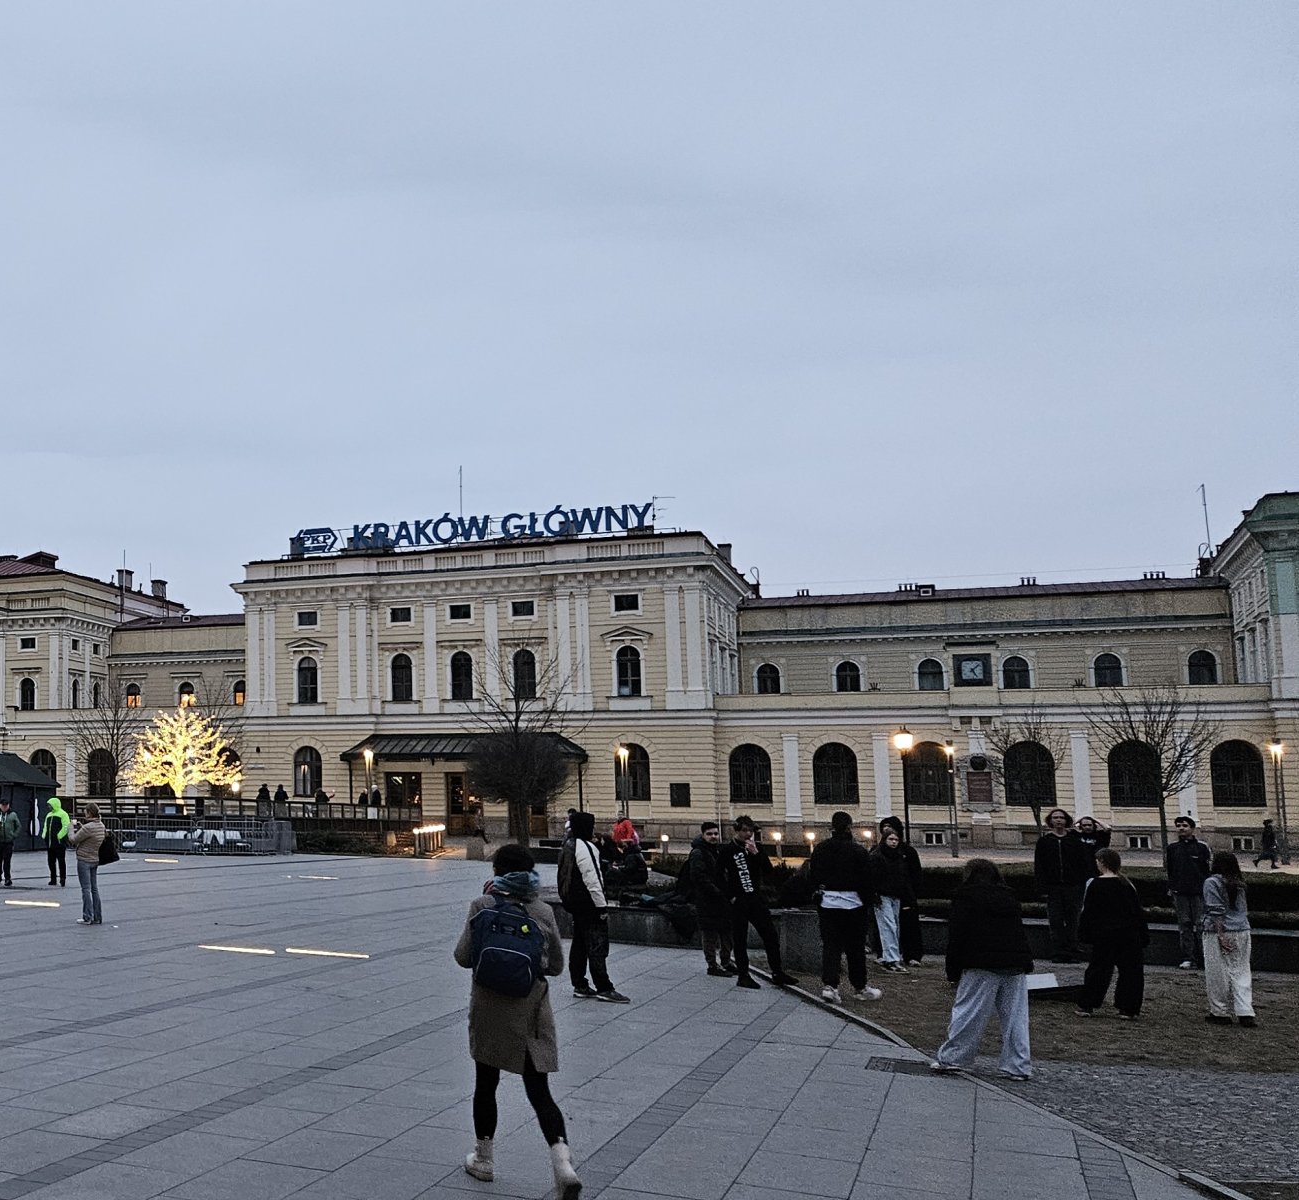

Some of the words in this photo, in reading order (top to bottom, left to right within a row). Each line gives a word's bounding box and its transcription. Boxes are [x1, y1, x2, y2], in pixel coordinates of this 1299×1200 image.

[301, 534, 331, 545] PKP
[353, 512, 490, 549] KRAKÓW
[500, 502, 653, 539] GŁÓWNY
